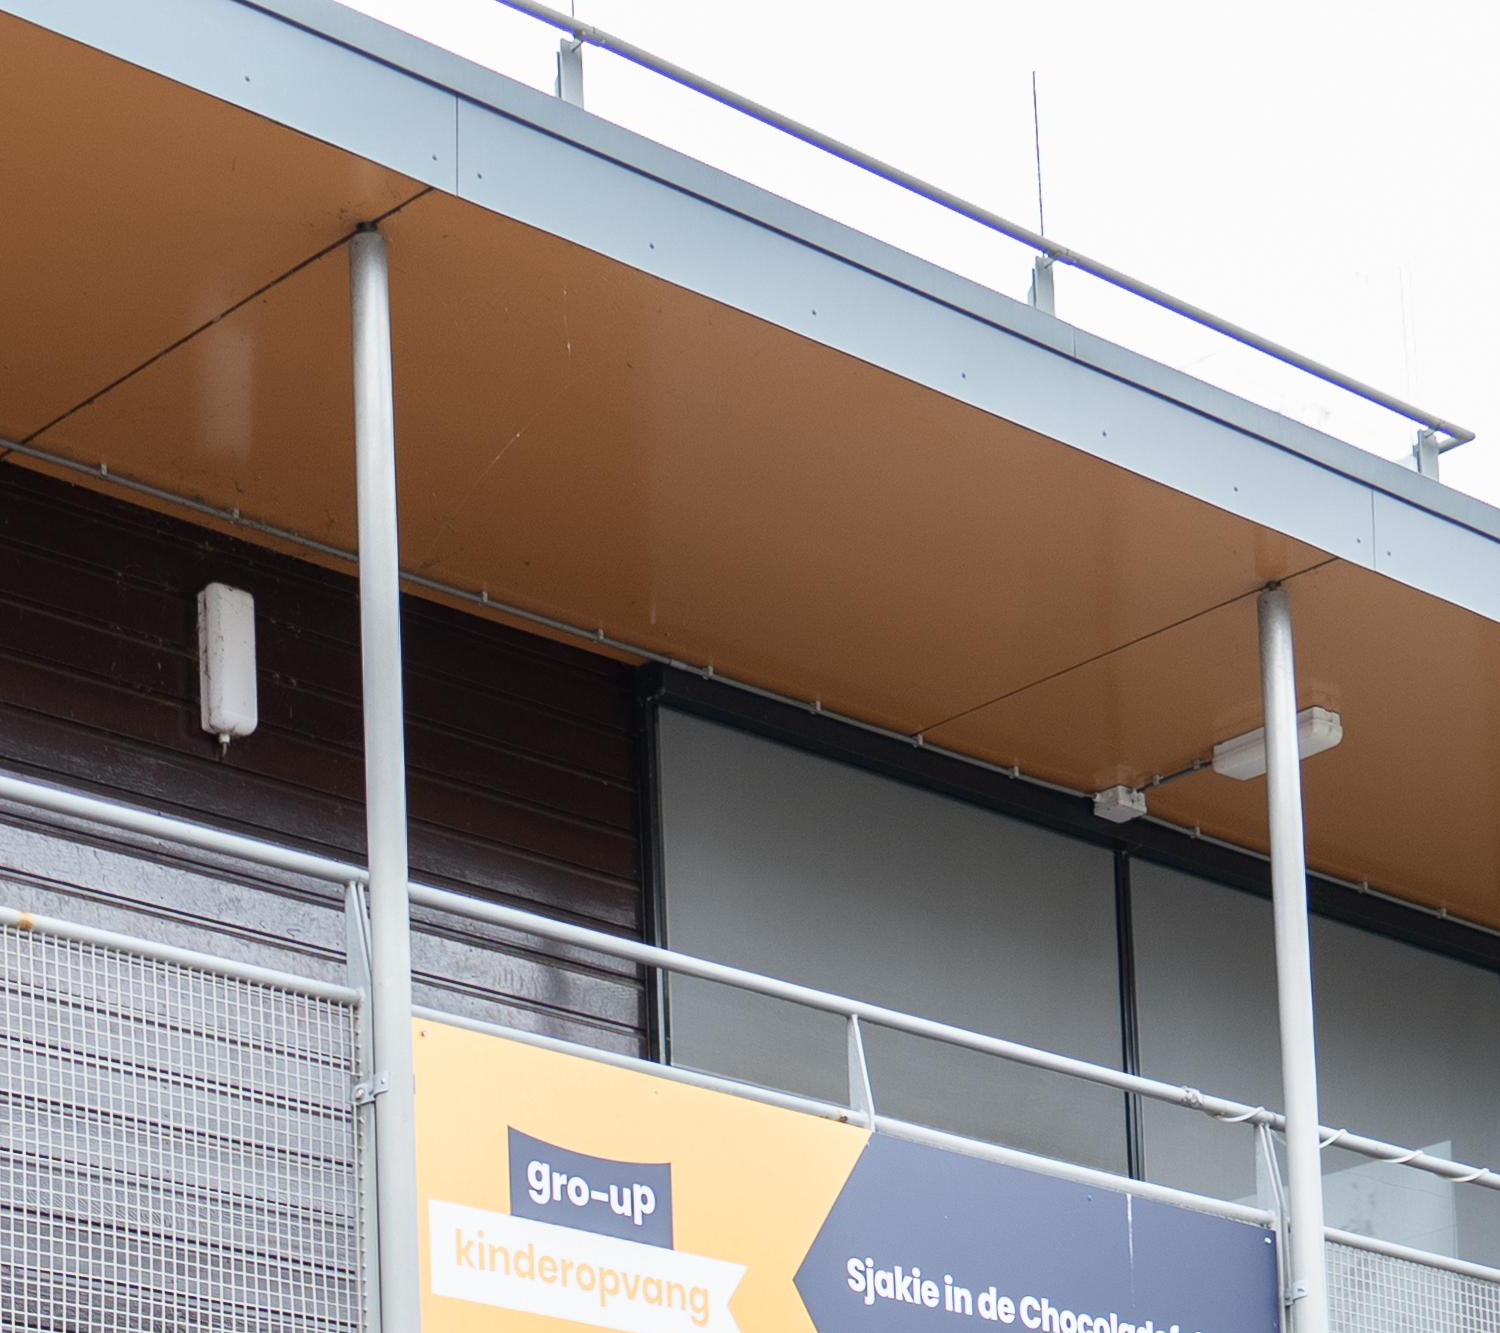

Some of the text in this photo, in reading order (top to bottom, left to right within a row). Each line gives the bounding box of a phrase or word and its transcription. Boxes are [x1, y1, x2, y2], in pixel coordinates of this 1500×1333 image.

[527, 1160, 656, 1225] gro-up
[455, 1228, 709, 1327] kinderopvang
[847, 1257, 940, 1306] Sjakie
[944, 1274, 973, 1316] in
[978, 1286, 1016, 1324] de
